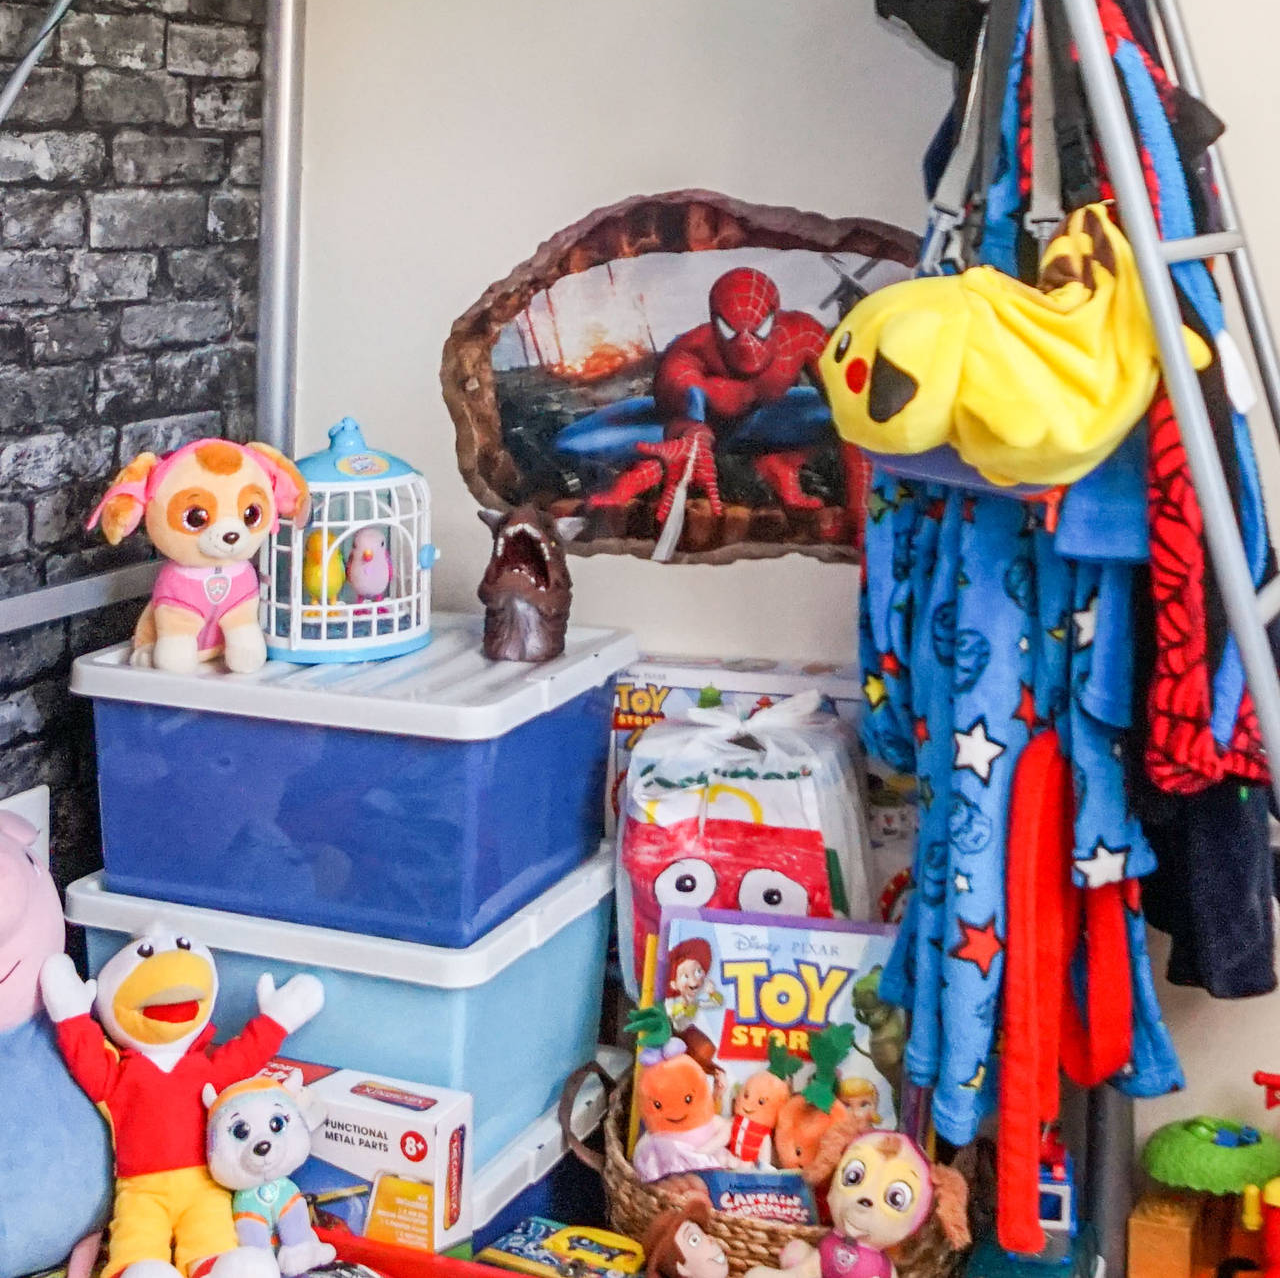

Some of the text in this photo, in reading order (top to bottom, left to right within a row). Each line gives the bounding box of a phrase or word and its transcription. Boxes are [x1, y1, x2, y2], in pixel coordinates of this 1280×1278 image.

[615, 683, 671, 714] TOY
[791, 941, 840, 956] PIXAR
[721, 958, 853, 1029] TOY
[730, 1025, 810, 1051] STOR
[323, 1118, 389, 1141] FUNCTIONAL
[325, 1130, 389, 1153] METAL PARTS
[405, 1136, 425, 1157] 8+
